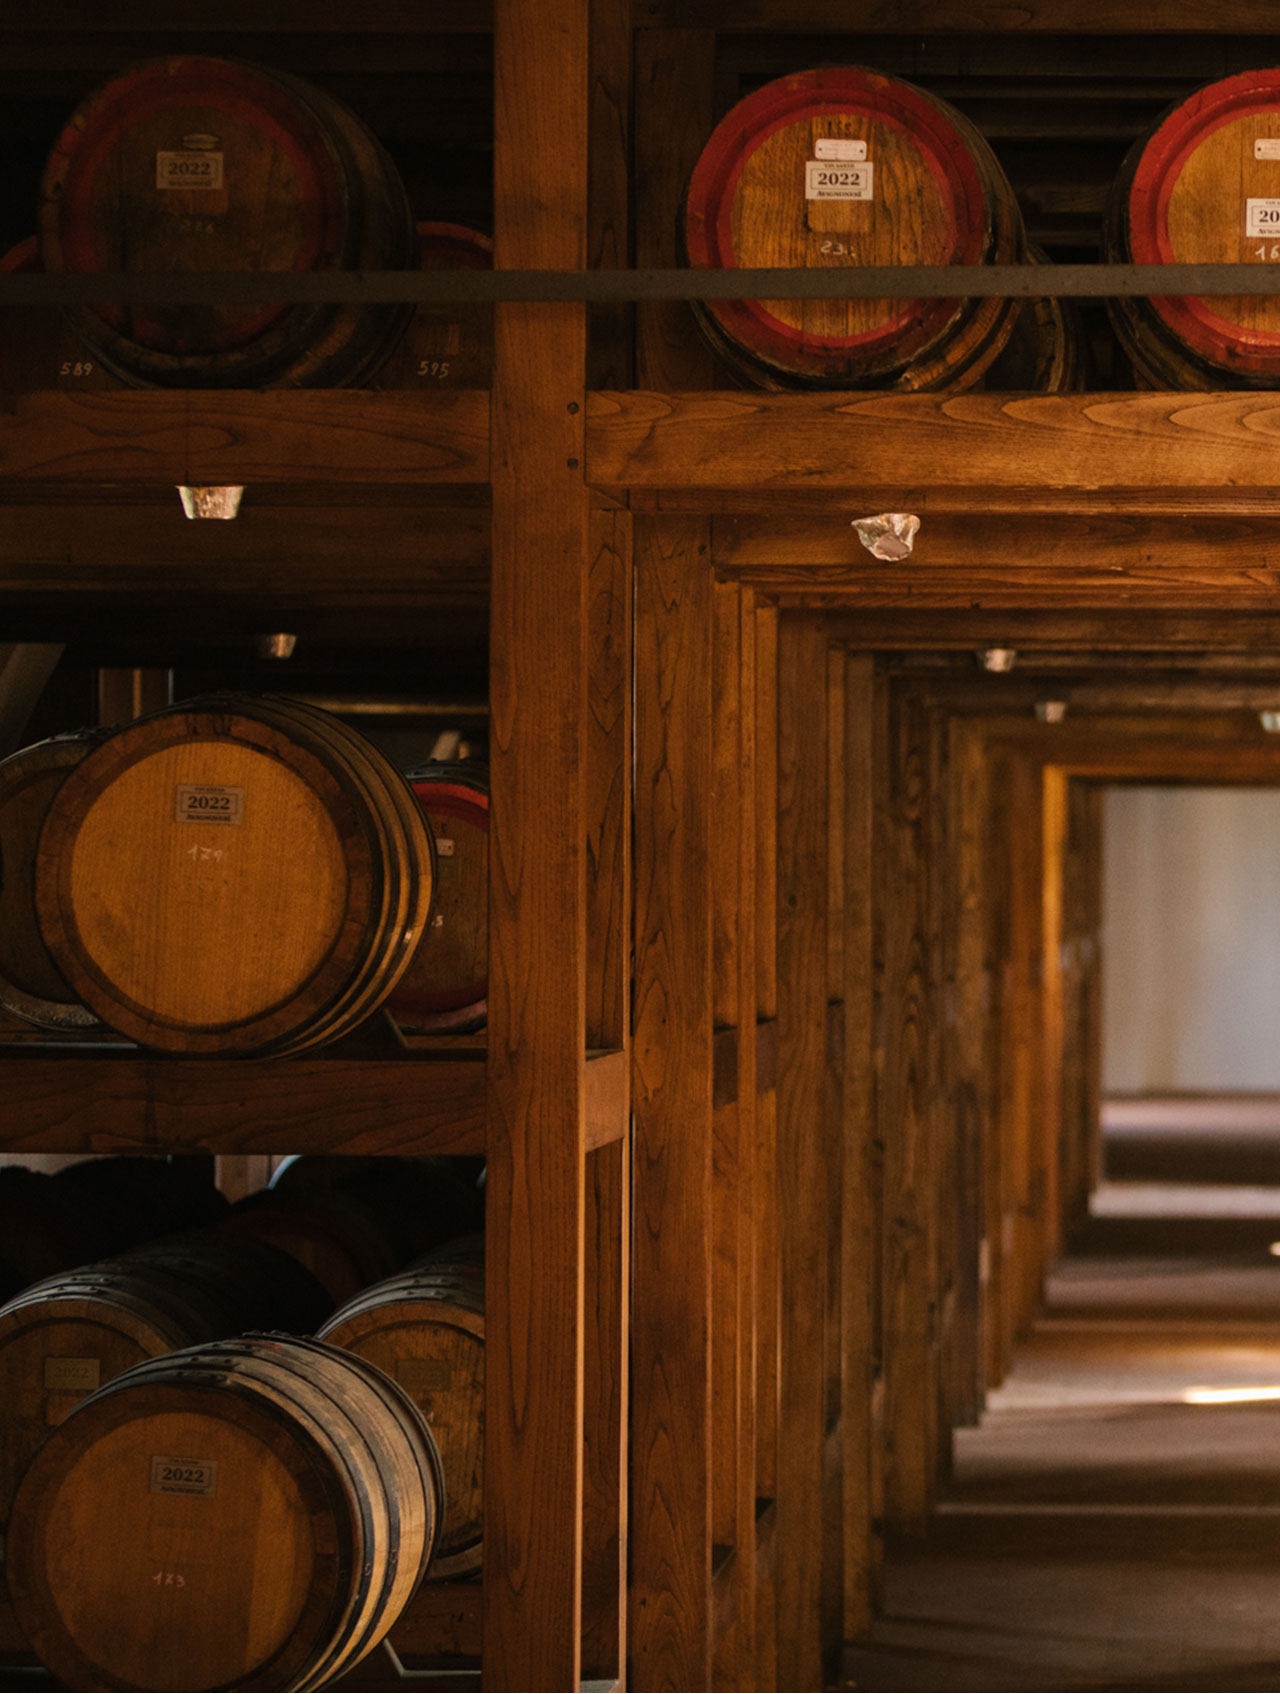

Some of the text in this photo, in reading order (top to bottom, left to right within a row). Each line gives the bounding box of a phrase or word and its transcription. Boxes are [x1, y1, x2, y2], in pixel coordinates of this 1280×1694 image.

[168, 162, 210, 175] 2022
[818, 172, 860, 186] 2022
[60, 361, 93, 376] 589
[417, 360, 449, 379] 595
[188, 795, 231, 810] 2022
[162, 1466, 204, 1483] 2022
